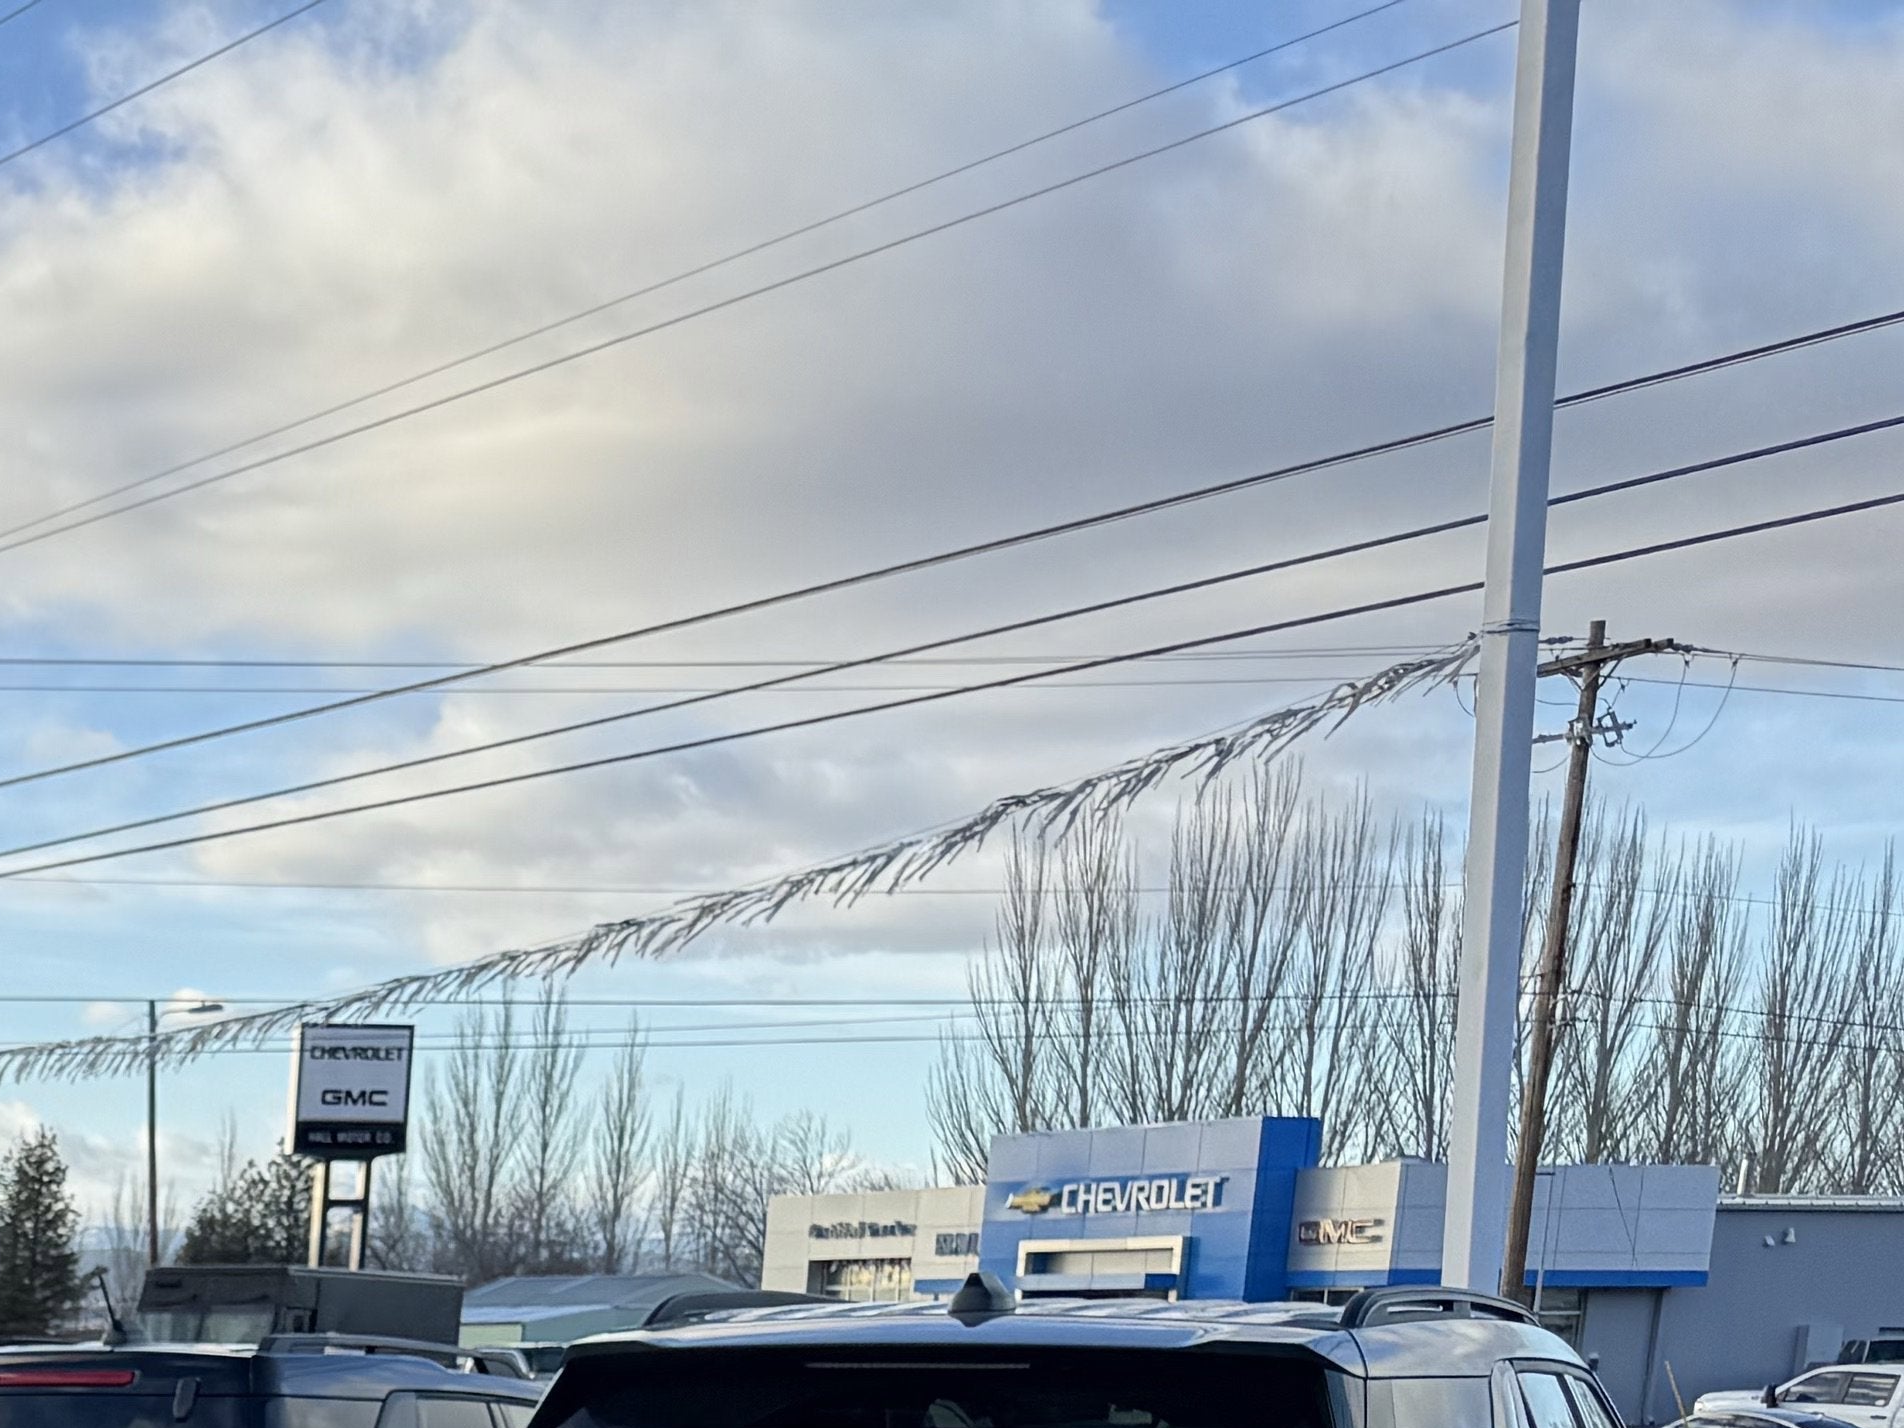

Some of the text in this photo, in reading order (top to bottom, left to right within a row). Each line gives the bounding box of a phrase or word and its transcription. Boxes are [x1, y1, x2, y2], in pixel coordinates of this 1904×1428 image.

[310, 1045, 404, 1061] CHEVROLET
[321, 1089, 389, 1107] GMC
[1060, 1176, 1223, 1215] CHEVROLET
[1299, 1217, 1384, 1245] GMC
